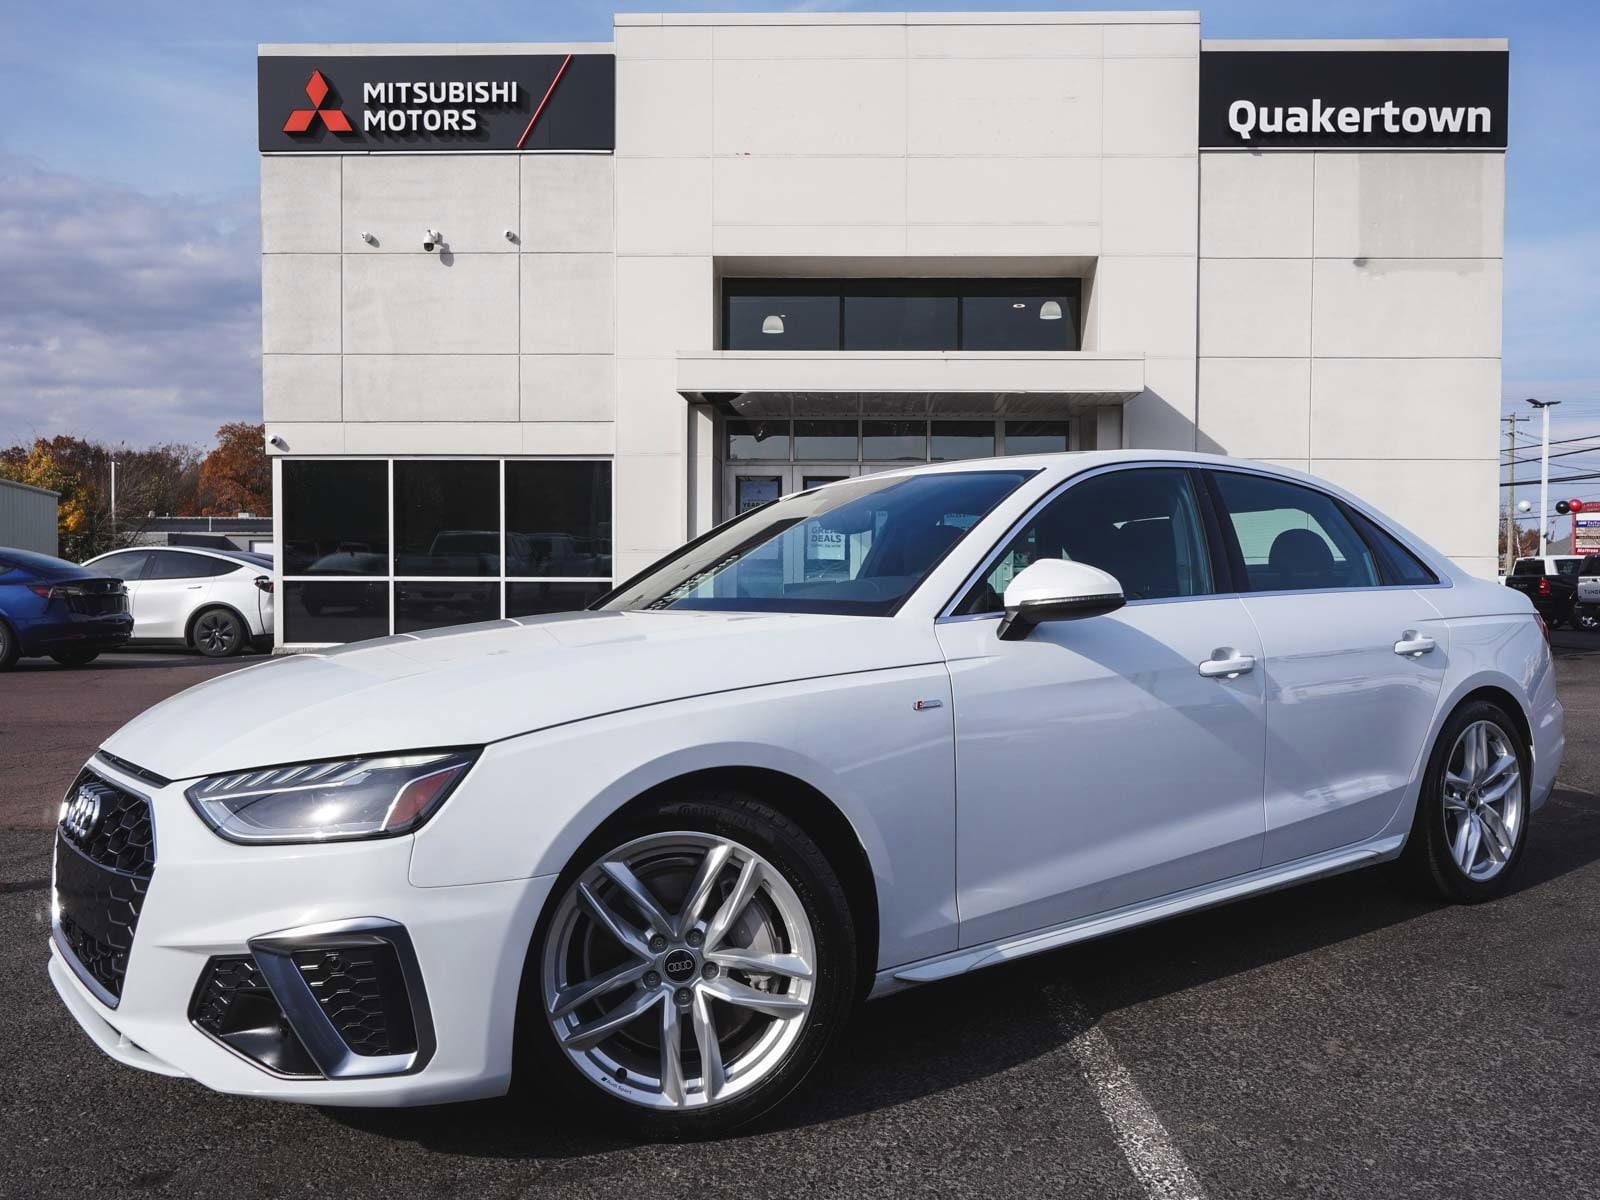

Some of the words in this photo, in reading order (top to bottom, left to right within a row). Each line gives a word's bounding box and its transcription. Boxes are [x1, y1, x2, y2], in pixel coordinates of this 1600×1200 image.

[363, 81, 517, 104] MITSUBISHI
[363, 109, 477, 132] MOTORS
[1228, 98, 1491, 139] Quakertown
[811, 535, 842, 543] DEALS
